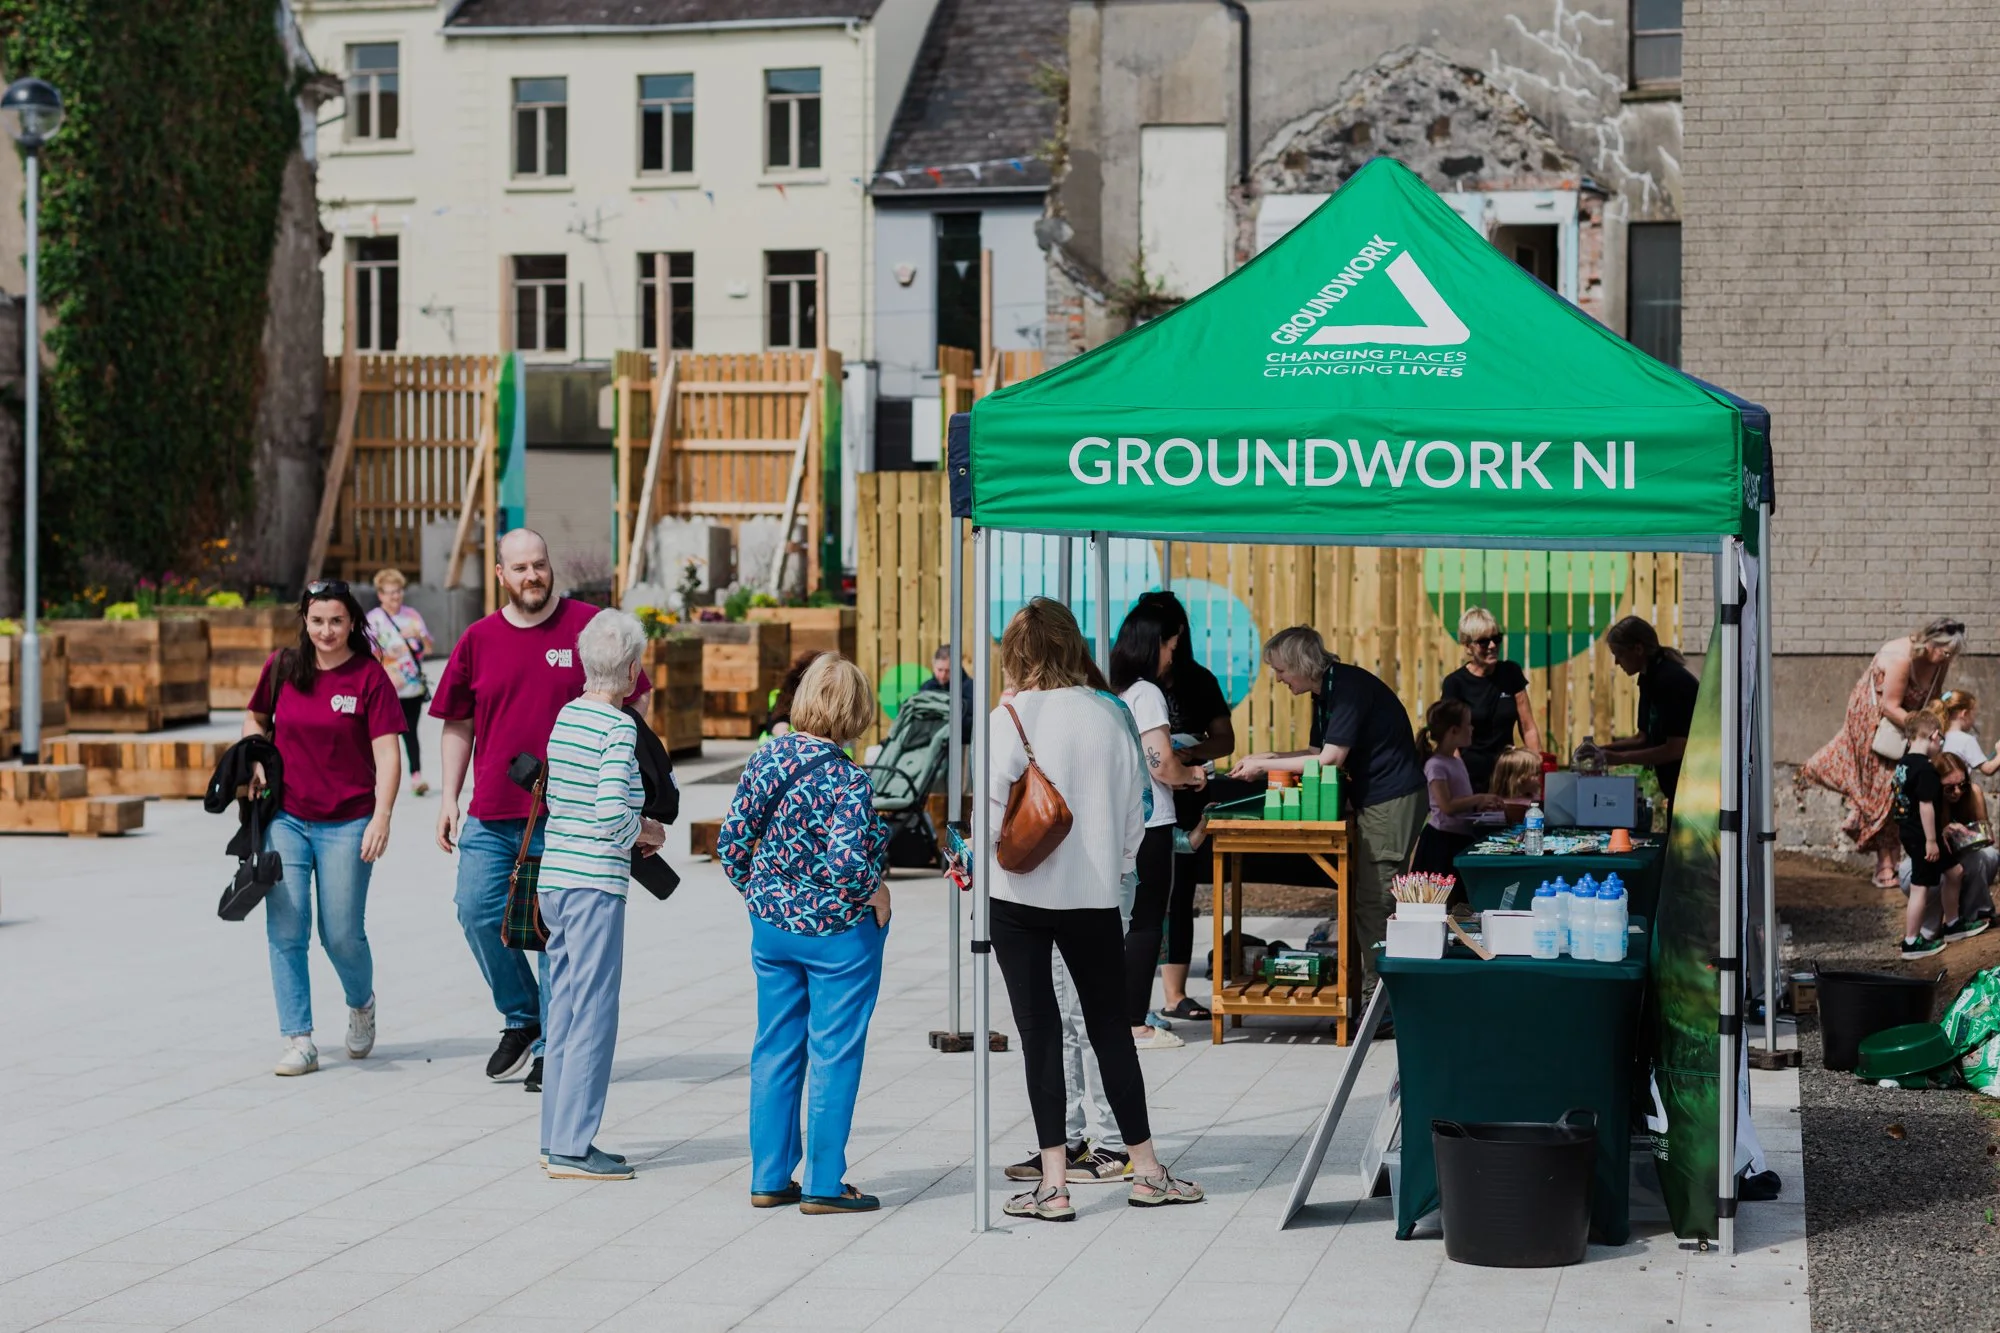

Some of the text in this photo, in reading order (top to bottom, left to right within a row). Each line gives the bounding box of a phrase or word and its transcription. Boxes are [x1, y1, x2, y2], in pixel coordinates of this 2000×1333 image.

[1270, 234, 1398, 345] GROUNDWORK
[1263, 365, 1463, 378] CHANGING LIVES
[1266, 349, 1467, 363] CHANGING PLACES
[1068, 436, 1635, 490] GROUNDWORK NI
